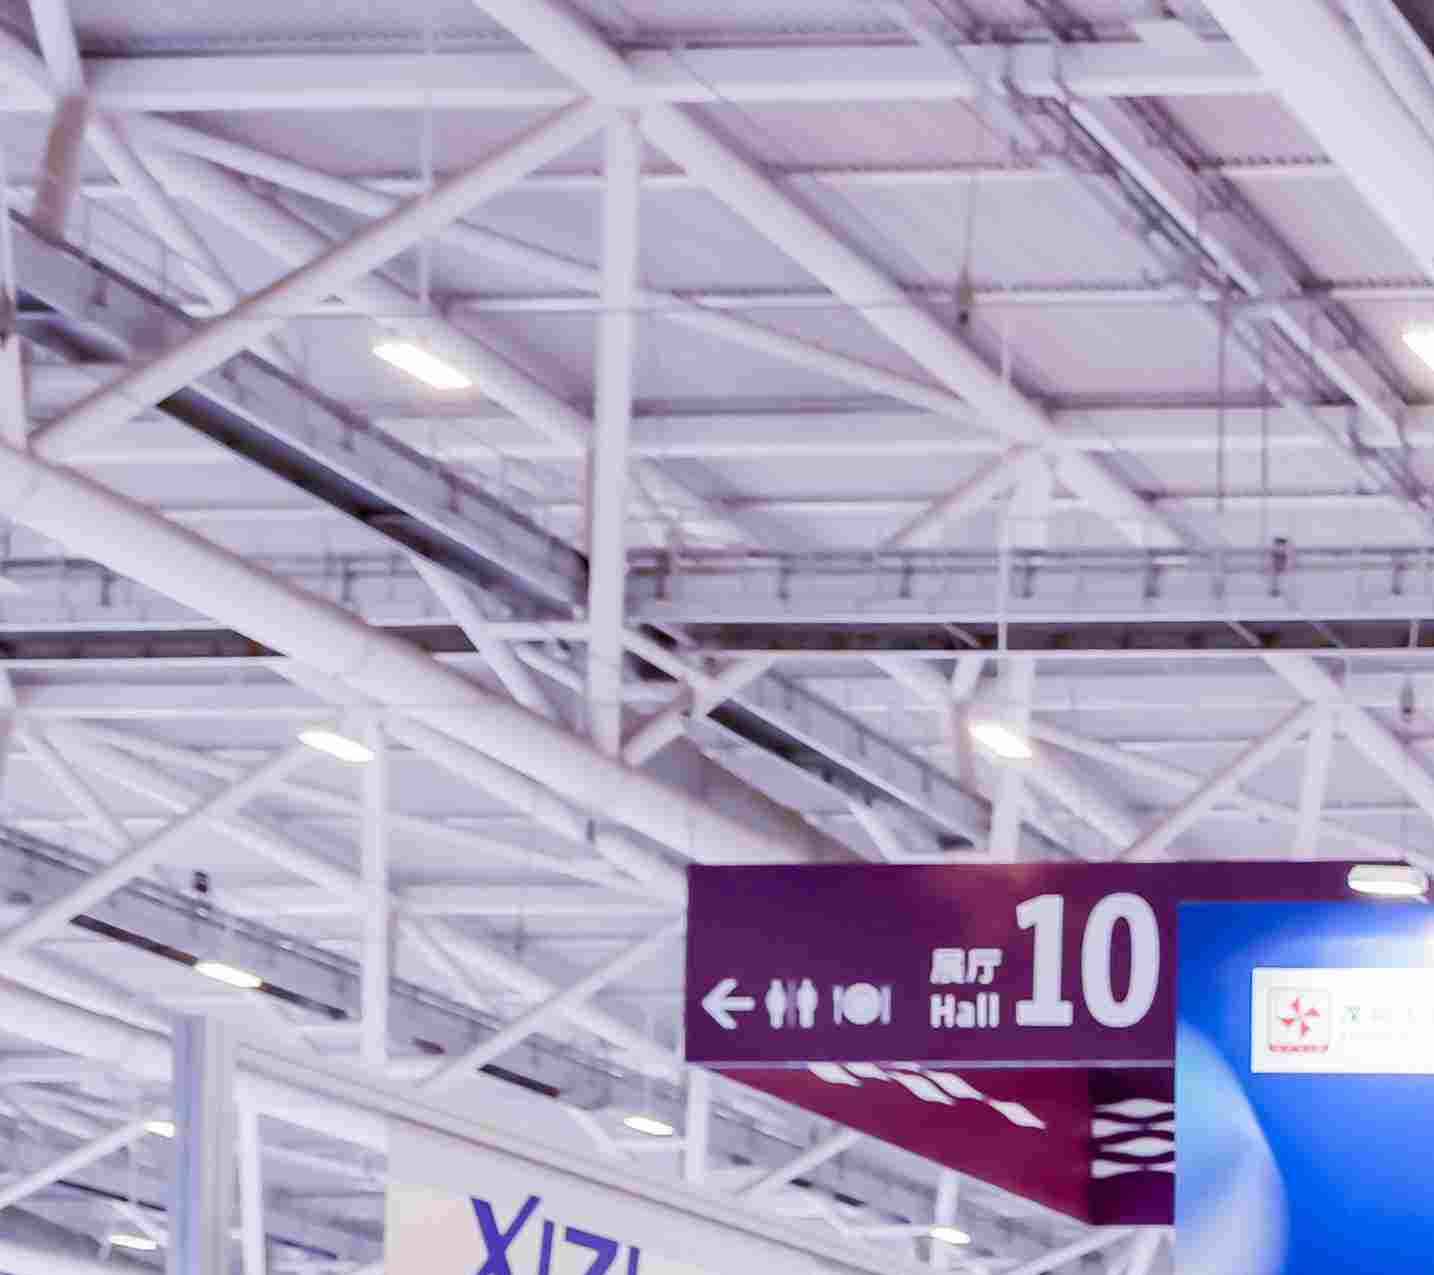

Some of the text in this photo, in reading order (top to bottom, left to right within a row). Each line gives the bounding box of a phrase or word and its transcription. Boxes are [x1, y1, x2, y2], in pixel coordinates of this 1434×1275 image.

[930, 892, 1160, 1028] Hall 10
[930, 948, 1002, 984] 展厅
